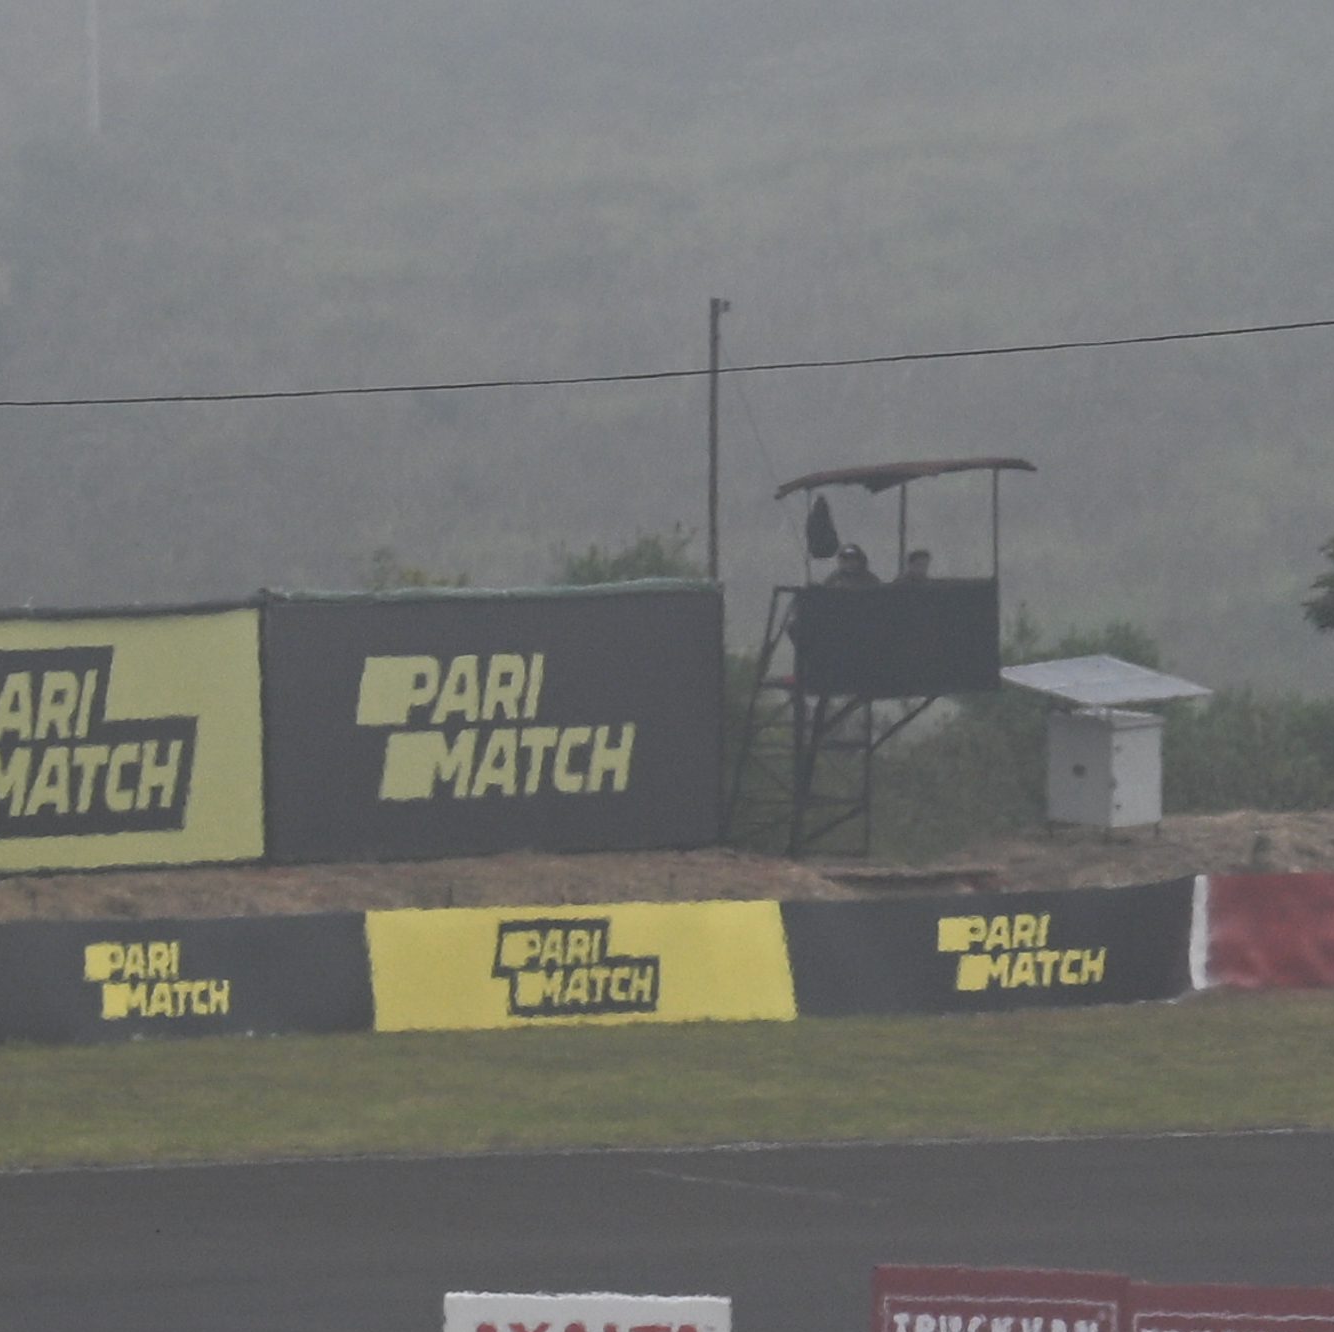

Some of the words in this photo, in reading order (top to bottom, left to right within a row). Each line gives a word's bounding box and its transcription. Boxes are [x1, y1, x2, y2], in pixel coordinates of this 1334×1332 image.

[356, 653, 545, 725] PARI
[379, 723, 635, 800] MATCH
[501, 927, 604, 969] PARI
[938, 915, 1050, 951] PARI
[84, 942, 179, 981] PARI
[957, 947, 1105, 990] MATCH
[101, 980, 230, 1020] MATCH
[515, 966, 654, 1006] MATCH
